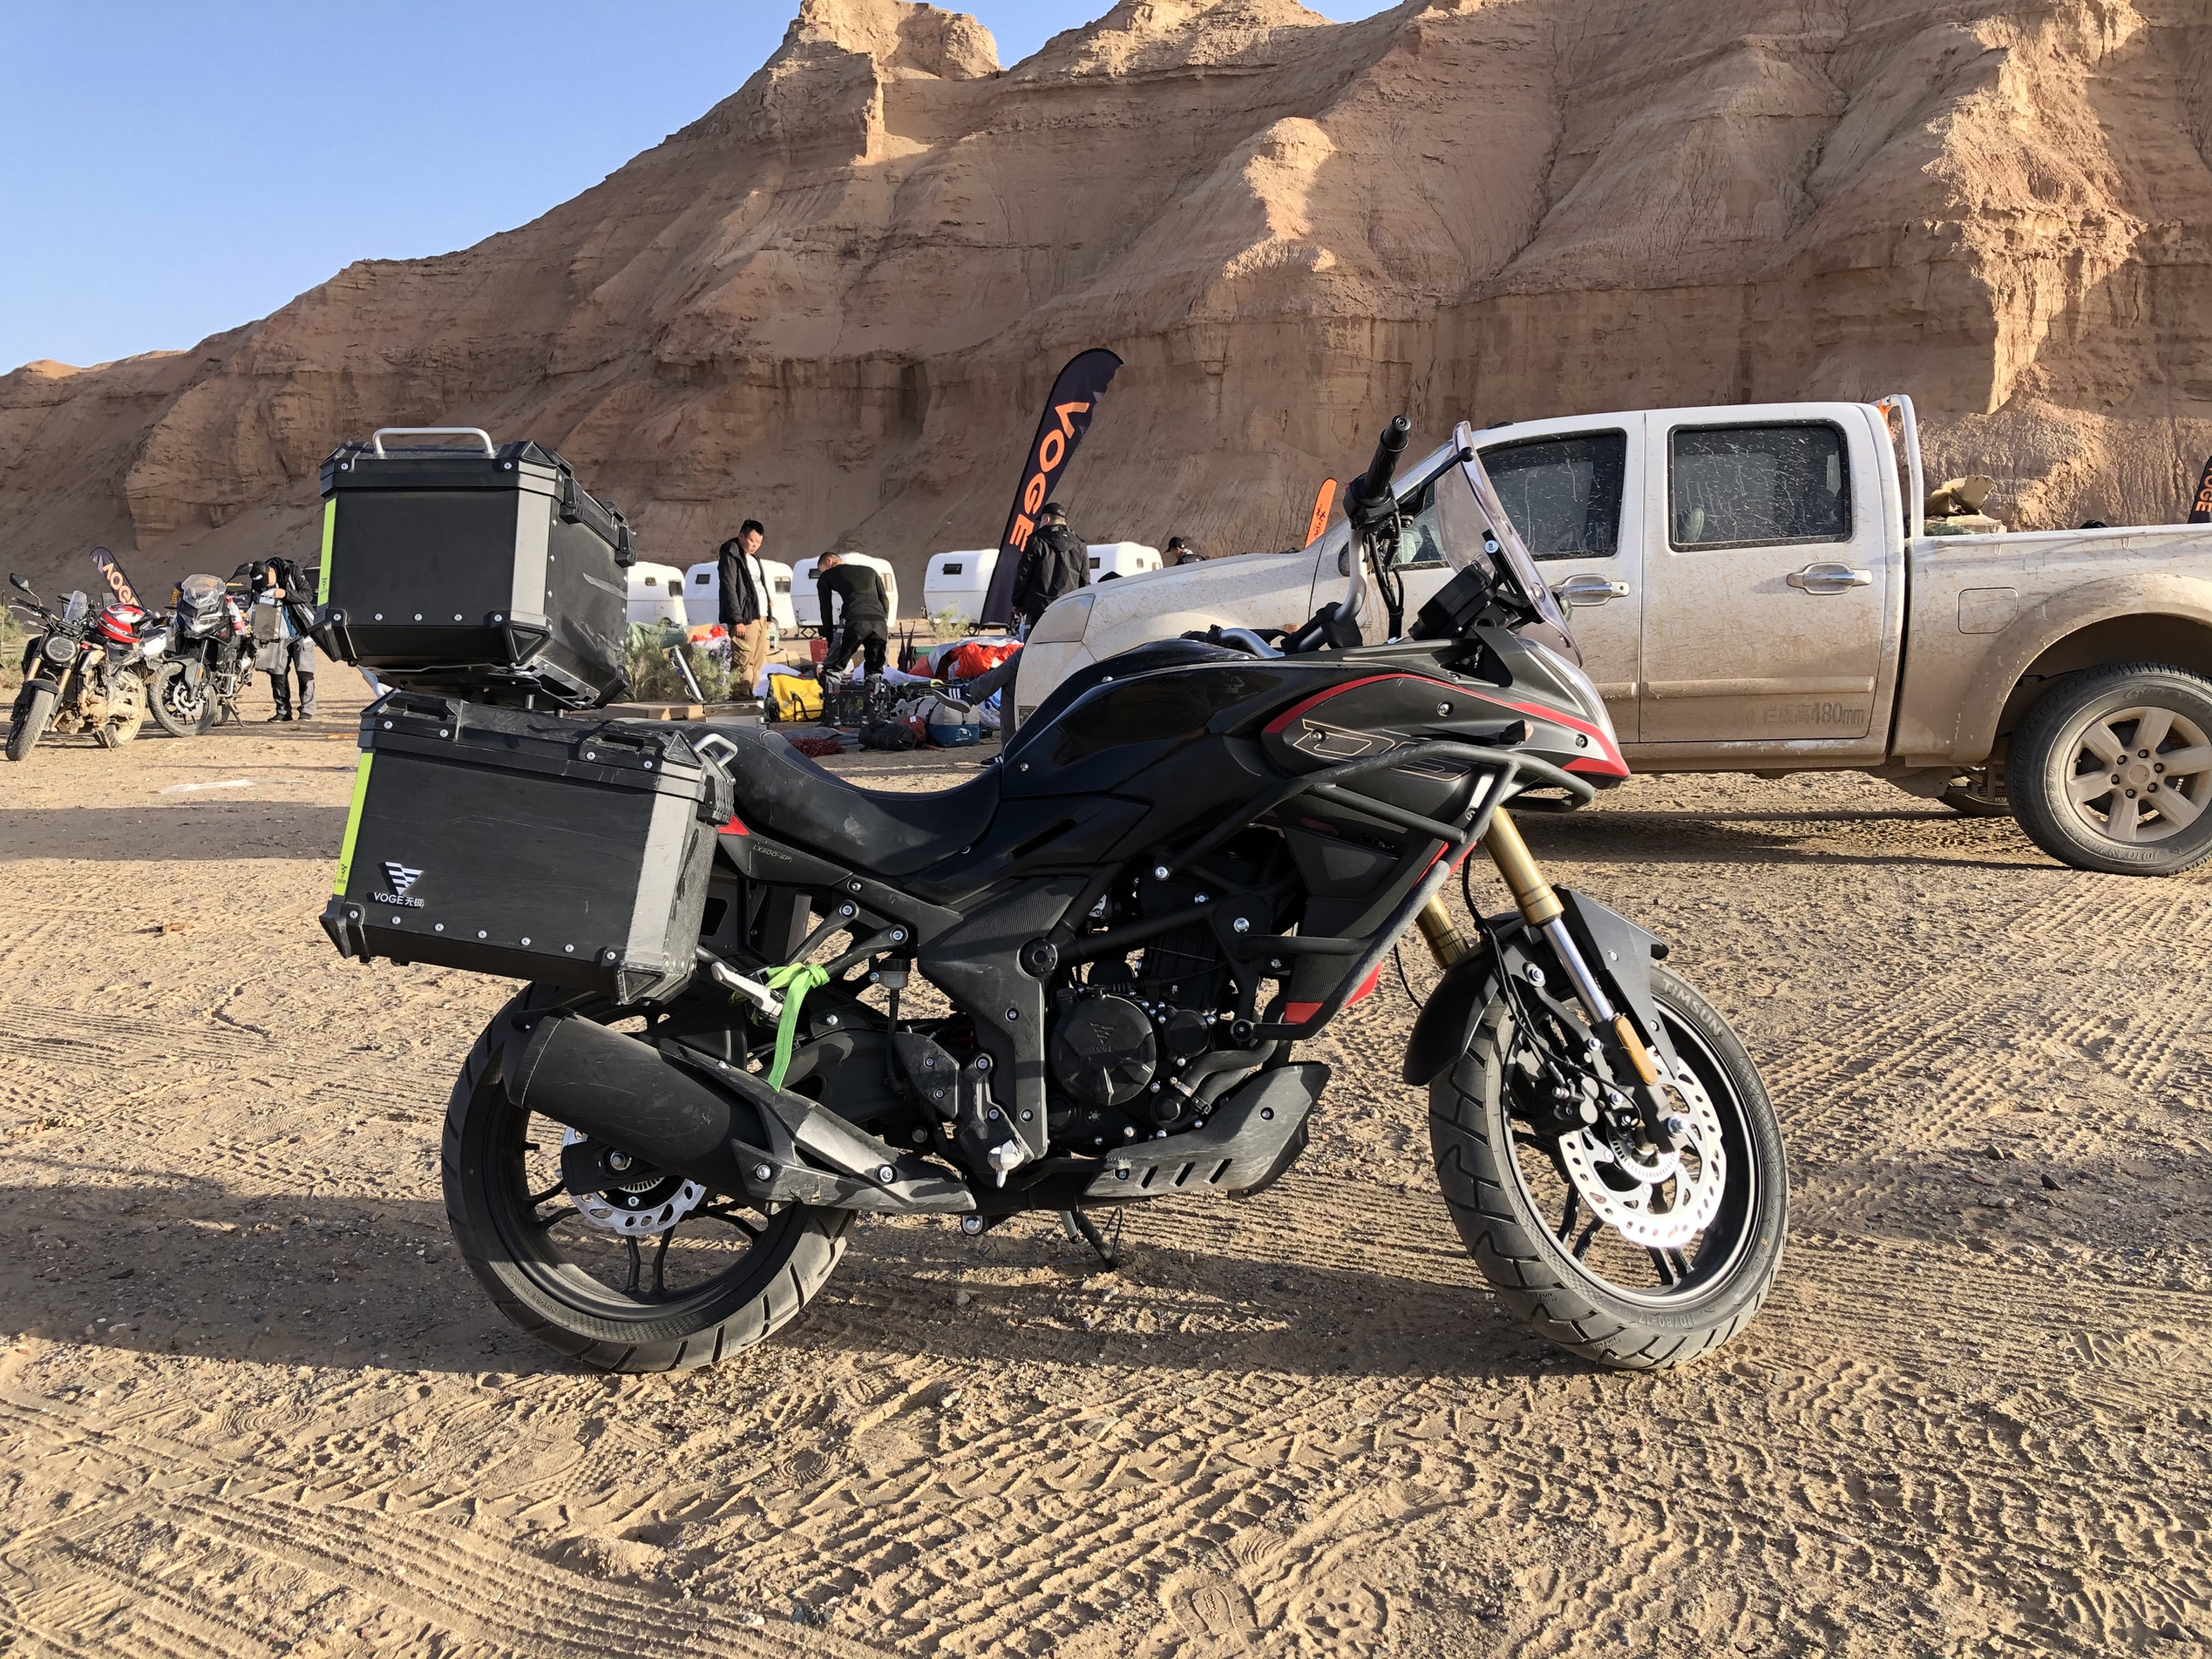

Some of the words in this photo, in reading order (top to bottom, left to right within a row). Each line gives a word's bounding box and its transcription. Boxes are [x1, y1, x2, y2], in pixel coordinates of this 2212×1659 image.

[1009, 402, 1089, 552] VOGE
[373, 892, 404, 904] VOGE
[404, 897, 424, 908] 无极
[1662, 978, 1722, 1035] TIMSUN
[1639, 1310, 1695, 1327] 110/80-17
